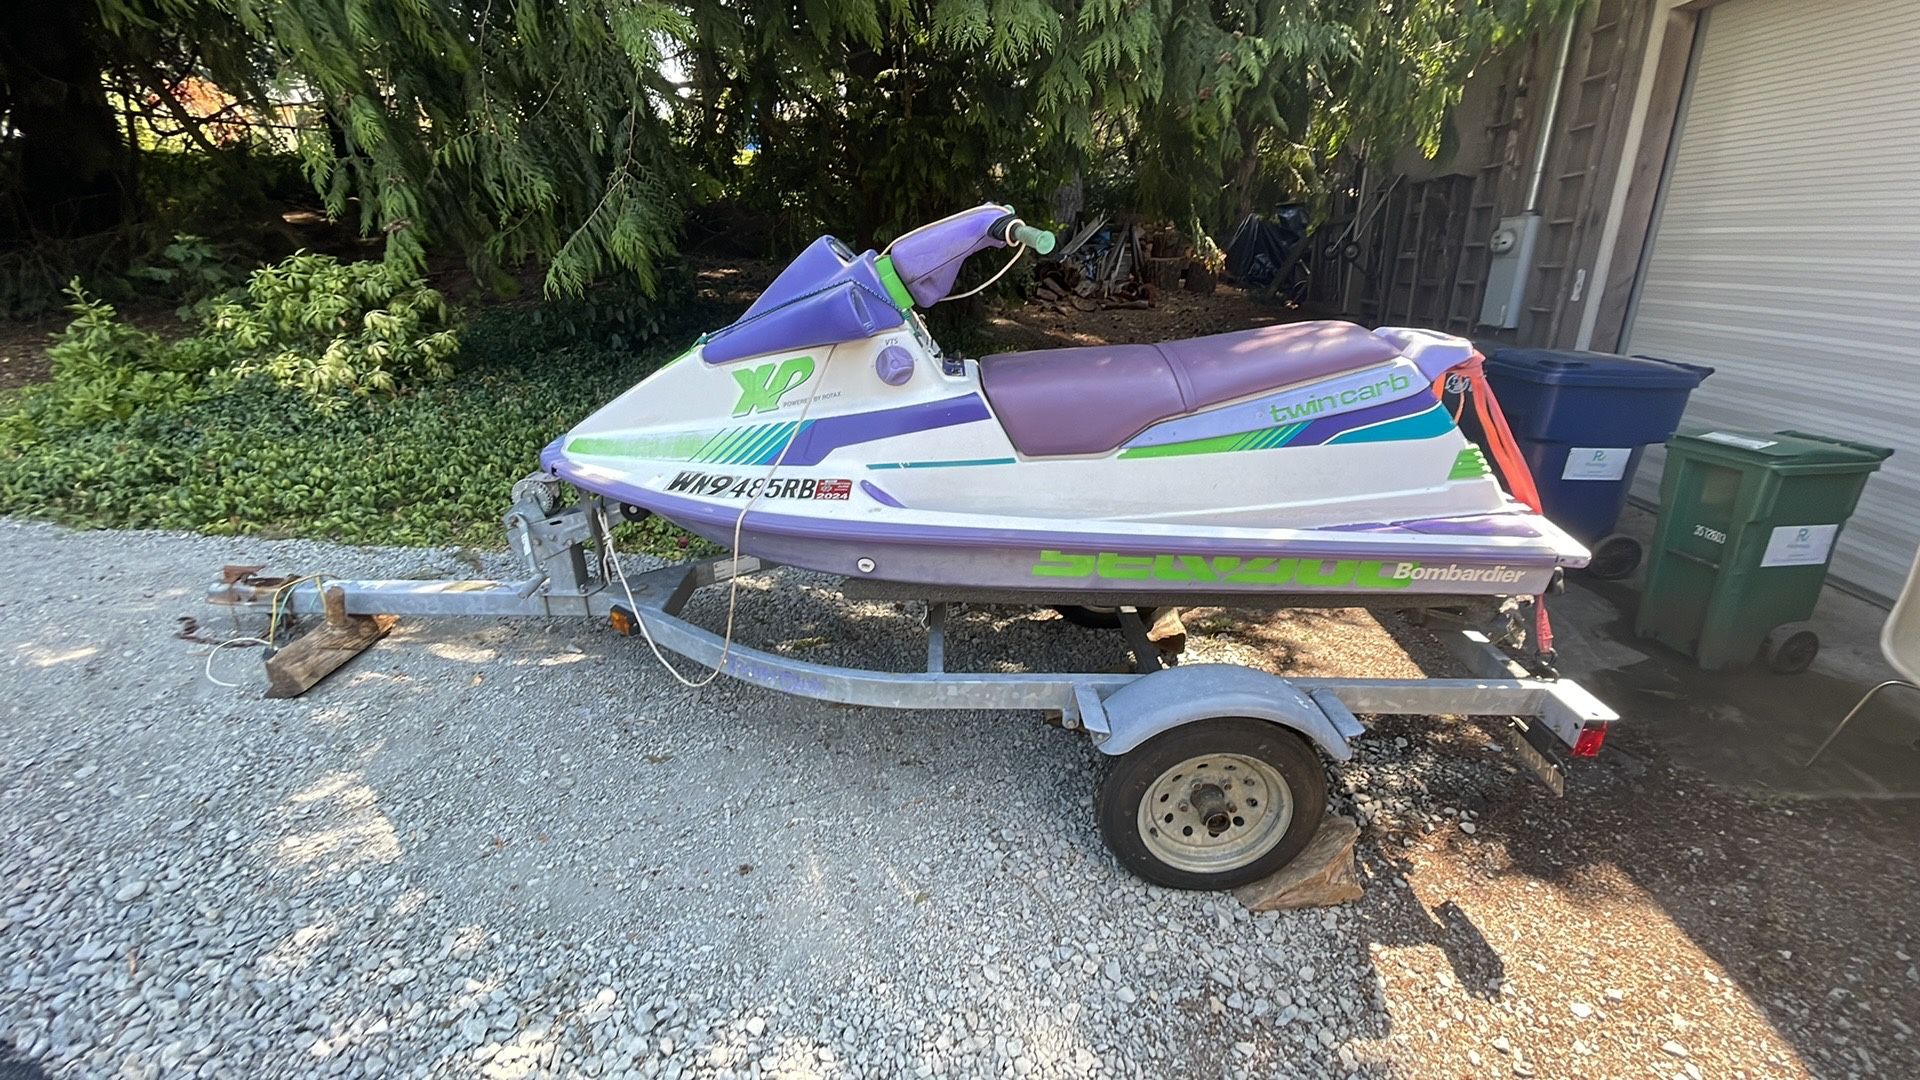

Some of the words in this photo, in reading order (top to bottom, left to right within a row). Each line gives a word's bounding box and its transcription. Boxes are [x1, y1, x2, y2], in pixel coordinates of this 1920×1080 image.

[885, 338, 899, 346] VTS
[731, 356, 815, 418] XP
[783, 397, 812, 407] POWERE
[1393, 562, 1526, 583] Bombardier
